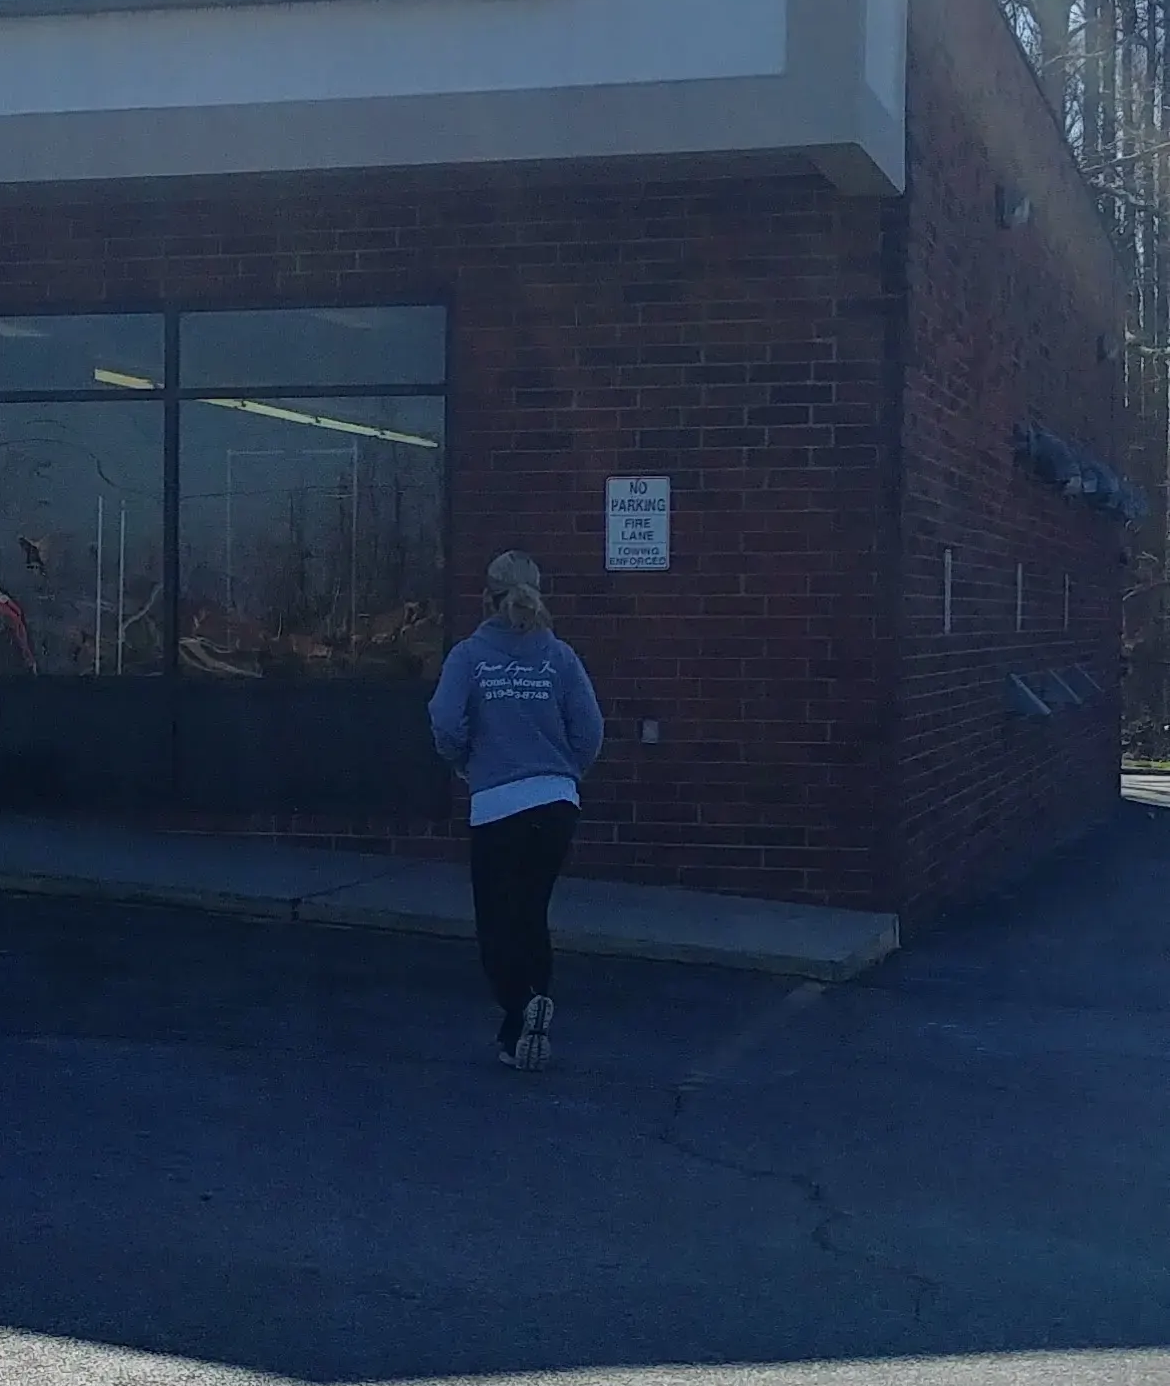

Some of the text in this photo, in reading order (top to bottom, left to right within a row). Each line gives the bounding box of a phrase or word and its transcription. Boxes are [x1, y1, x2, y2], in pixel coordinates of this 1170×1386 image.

[629, 481, 648, 495] NO
[610, 498, 666, 512] PARKING
[624, 518, 652, 529] FIRE
[621, 531, 655, 541] LANE
[617, 547, 660, 556] TOWING
[609, 557, 667, 566] ENFORCED
